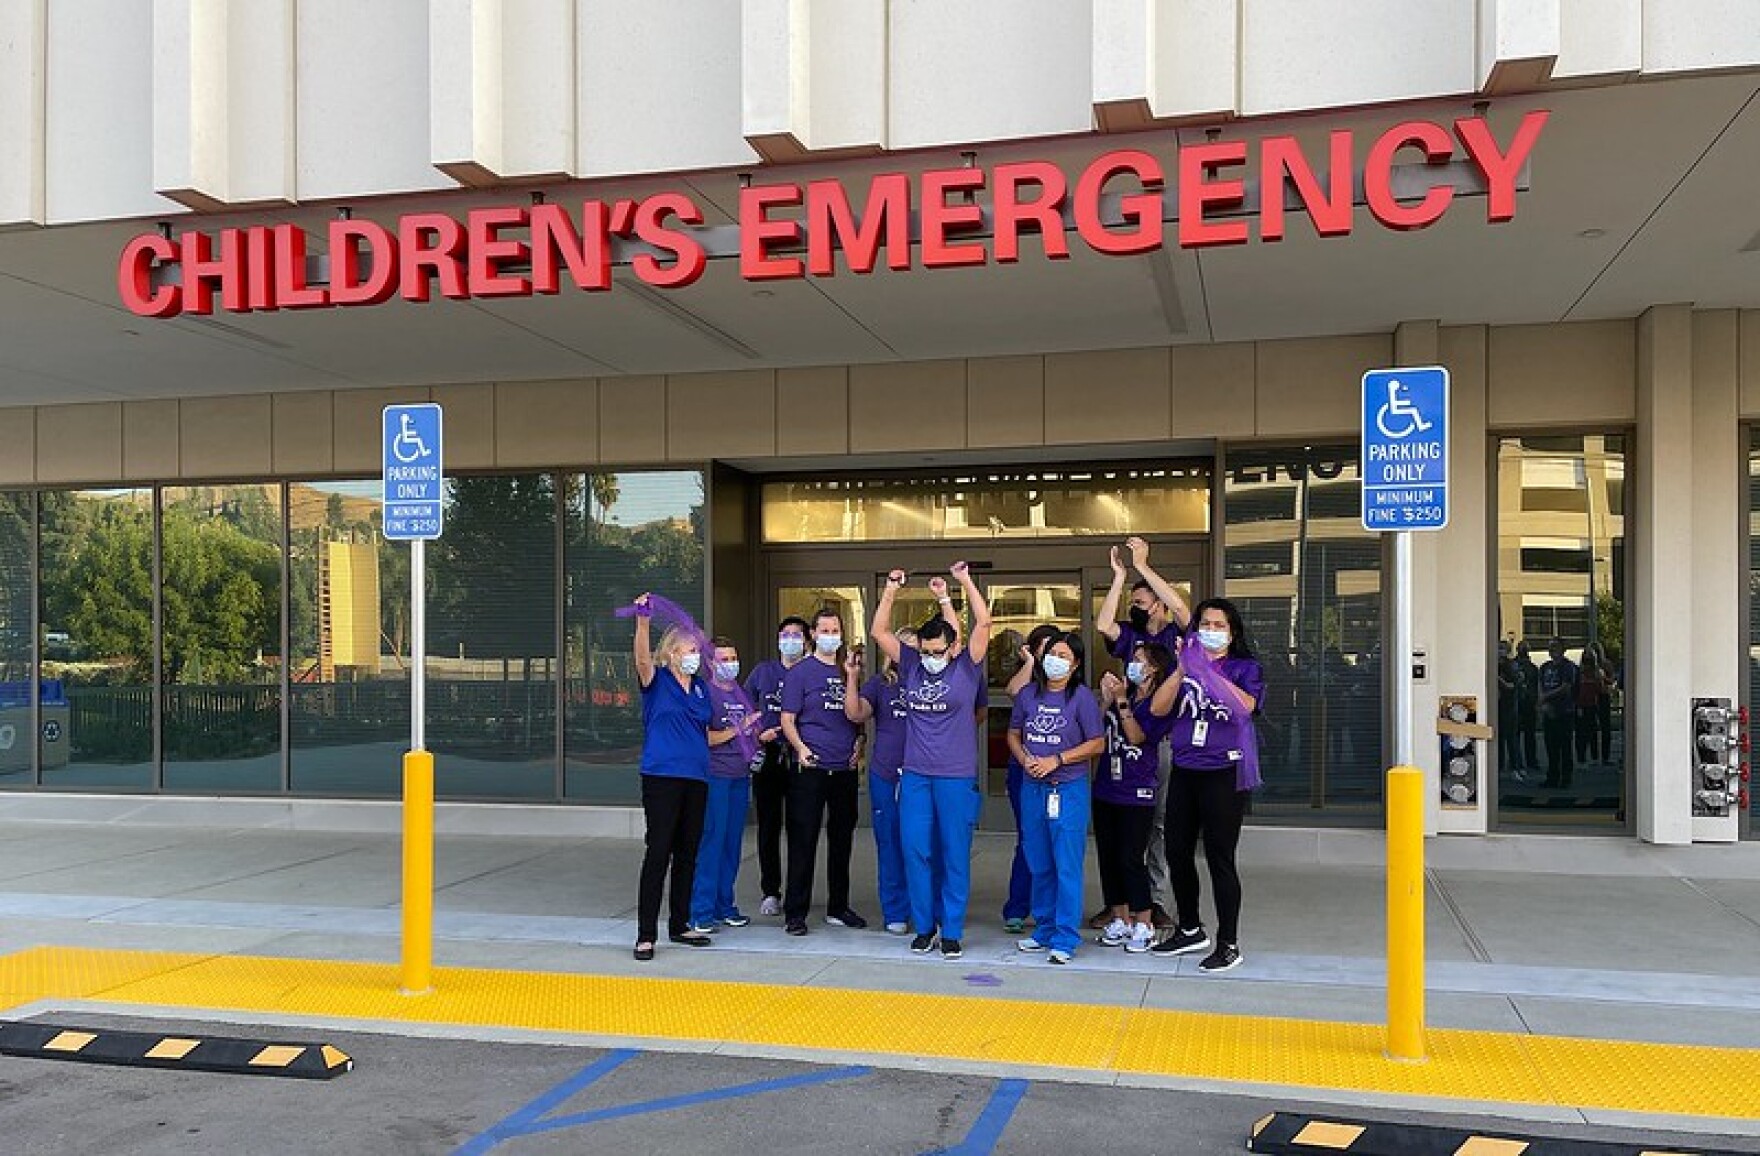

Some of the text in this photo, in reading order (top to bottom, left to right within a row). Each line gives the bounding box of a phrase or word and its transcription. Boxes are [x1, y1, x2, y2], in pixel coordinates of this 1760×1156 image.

[116, 109, 1552, 318] CHILDREN'S EMERGENCY
[1369, 442, 1441, 461] PARKING
[387, 465, 437, 481] PARKING
[1383, 463, 1426, 482] ONLY
[397, 484, 428, 498] ONLY
[1376, 489, 1433, 504] MINIMUM
[1368, 505, 1442, 522] FINE $250
